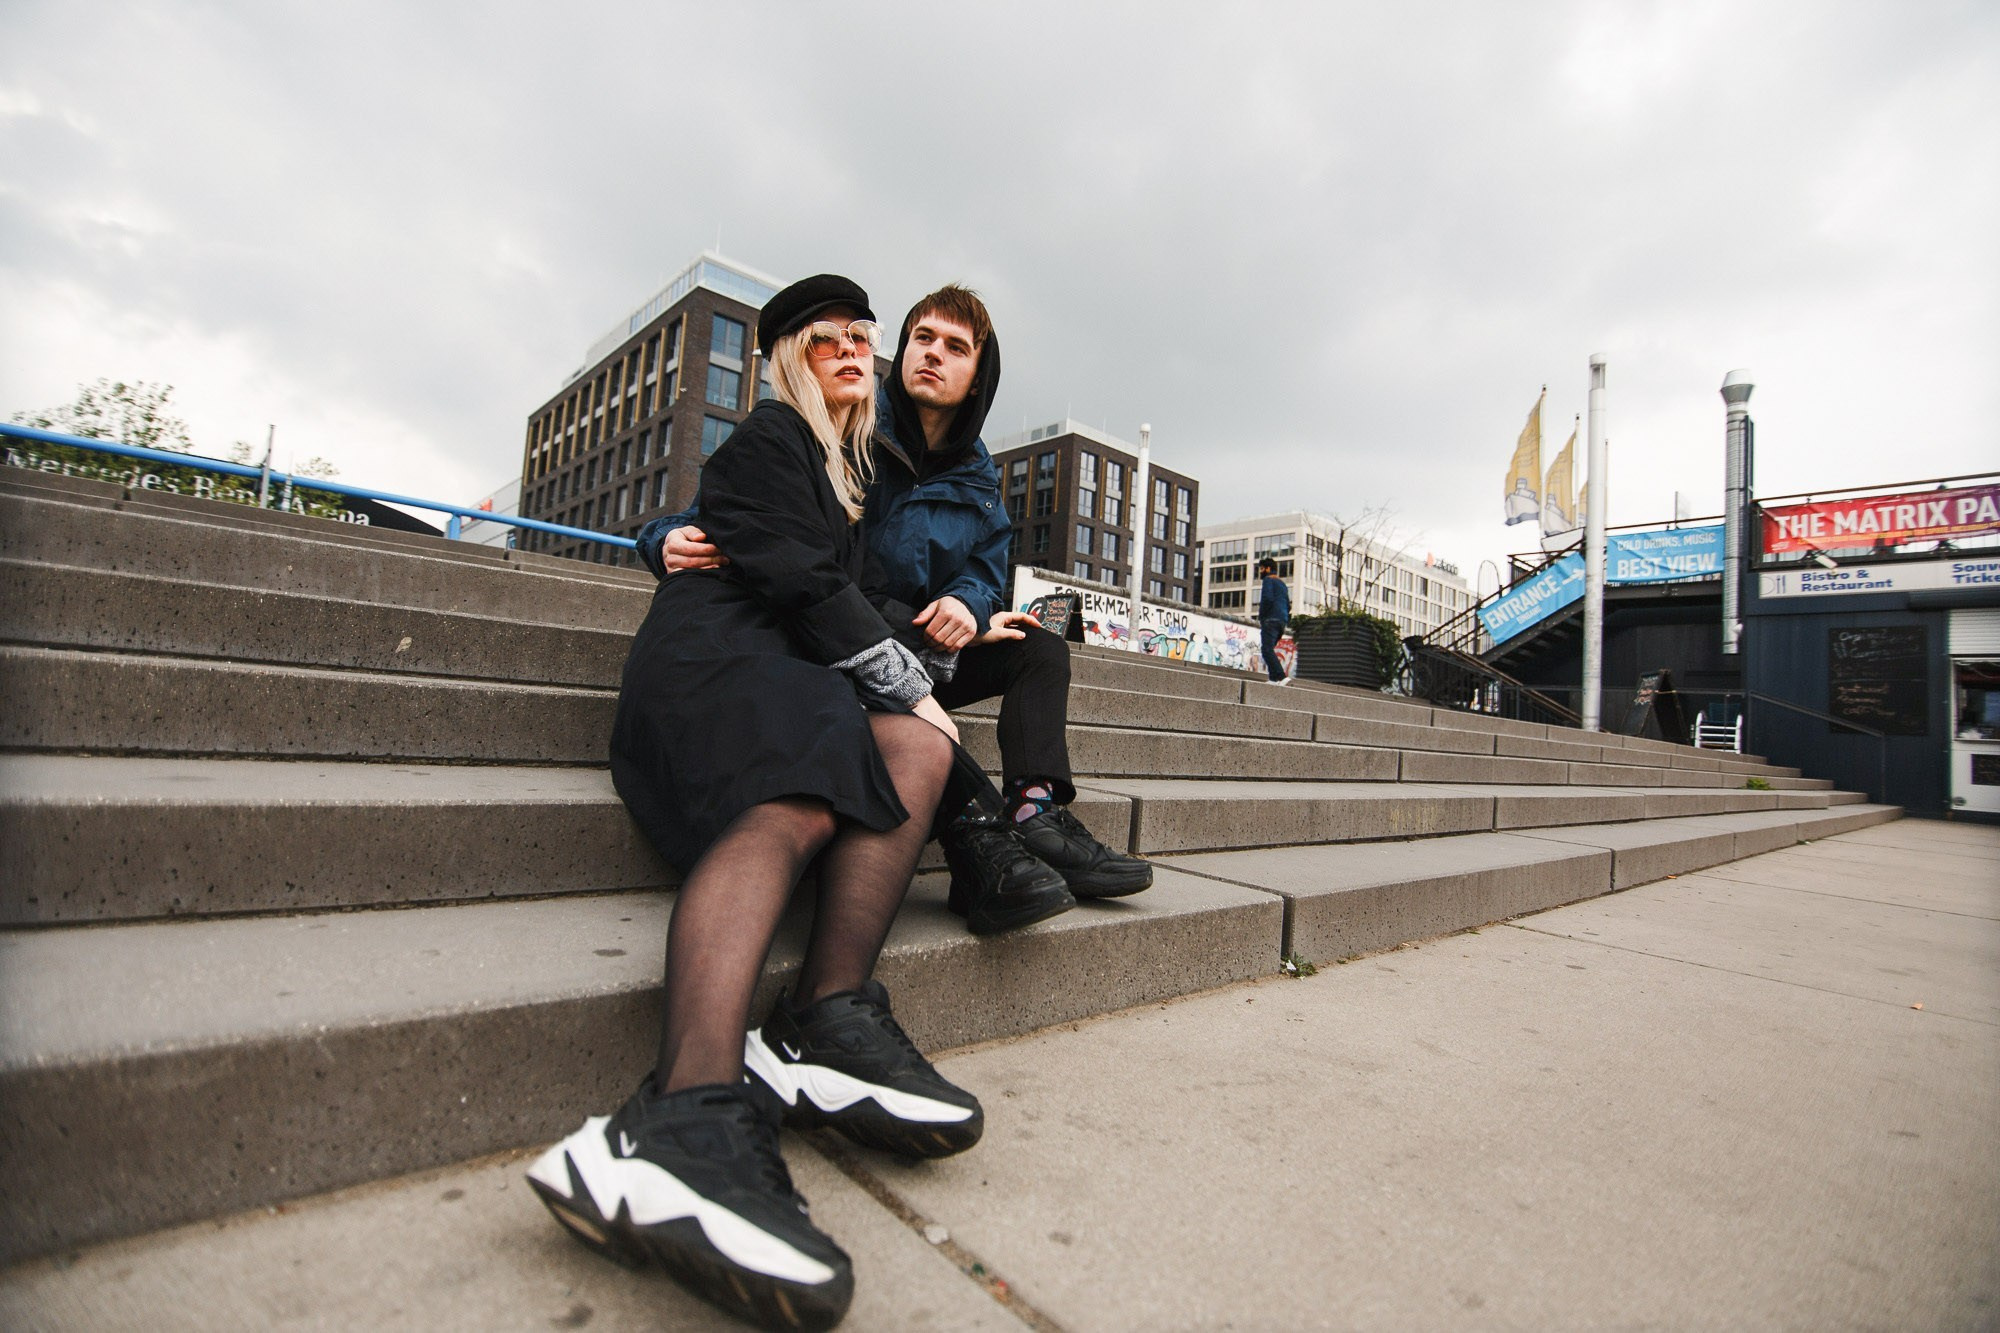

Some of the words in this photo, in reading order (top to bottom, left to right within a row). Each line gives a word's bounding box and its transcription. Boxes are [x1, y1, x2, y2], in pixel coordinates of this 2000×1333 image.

[1774, 512, 1825, 539] THE
[1834, 501, 1948, 535] MATRIX
[1958, 495, 2000, 524] PA
[1684, 532, 1716, 545] MUSIC
[1617, 557, 1661, 578] BEST
[1666, 552, 1716, 573] VIEW
[1952, 563, 2000, 573] Souv
[1801, 571, 1850, 583] Bistro
[1857, 569, 1869, 578] &
[1801, 579, 1893, 592] Restaurant
[1484, 574, 1561, 630] ENTRANCE
